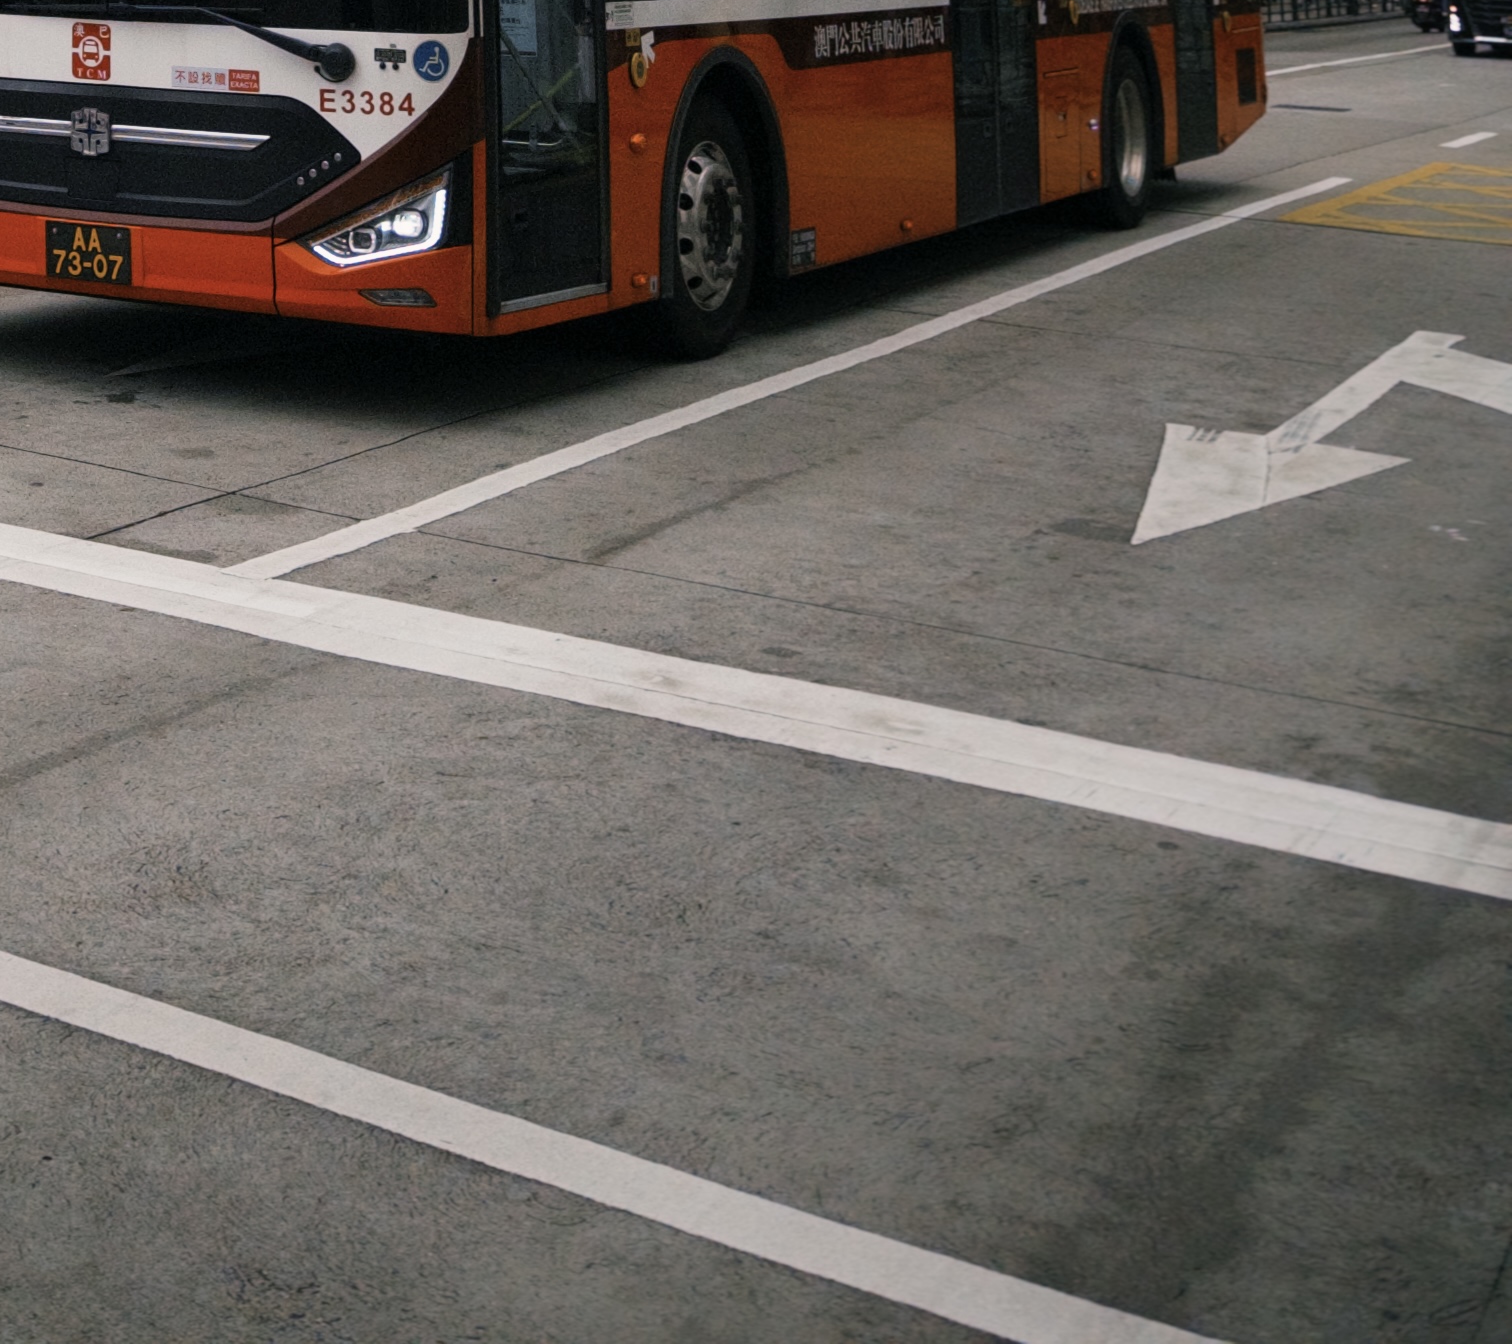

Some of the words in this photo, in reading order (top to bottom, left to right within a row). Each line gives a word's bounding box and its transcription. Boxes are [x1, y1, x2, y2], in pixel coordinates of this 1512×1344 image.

[813, 14, 946, 59] 澳門公共汽車股份有限公司
[76, 67, 107, 80] TCM
[230, 81, 259, 89] EXACTA
[231, 72, 257, 81] TARIFA
[319, 88, 416, 117] E3384
[72, 226, 102, 253] AA
[52, 249, 124, 281] 73-07
